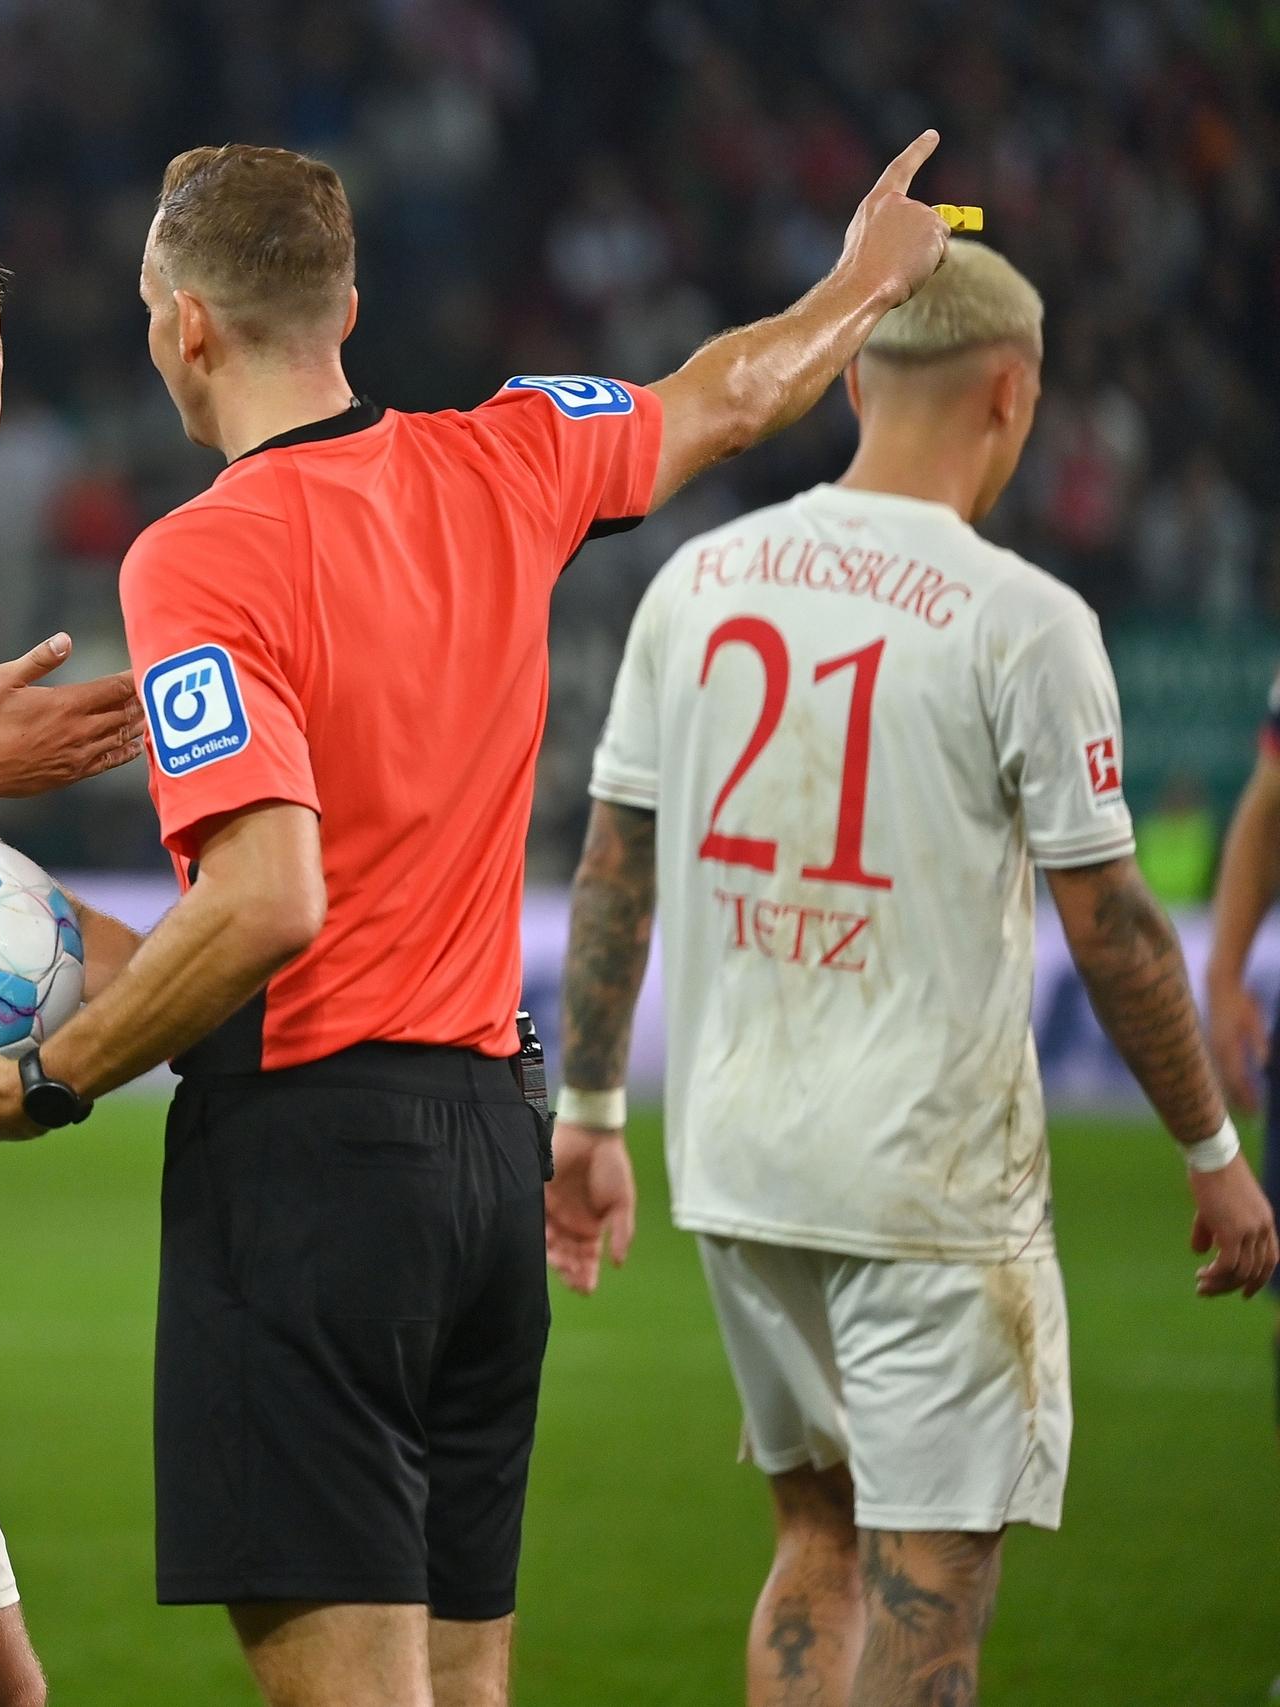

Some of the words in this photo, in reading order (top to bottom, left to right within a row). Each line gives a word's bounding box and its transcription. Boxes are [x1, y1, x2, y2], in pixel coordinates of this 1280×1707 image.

[692, 537, 743, 594] FC
[743, 536, 973, 629] AUGSBURG
[169, 752, 191, 769] Das
[191, 734, 239, 759] Örtliche
[699, 612, 893, 890] 21
